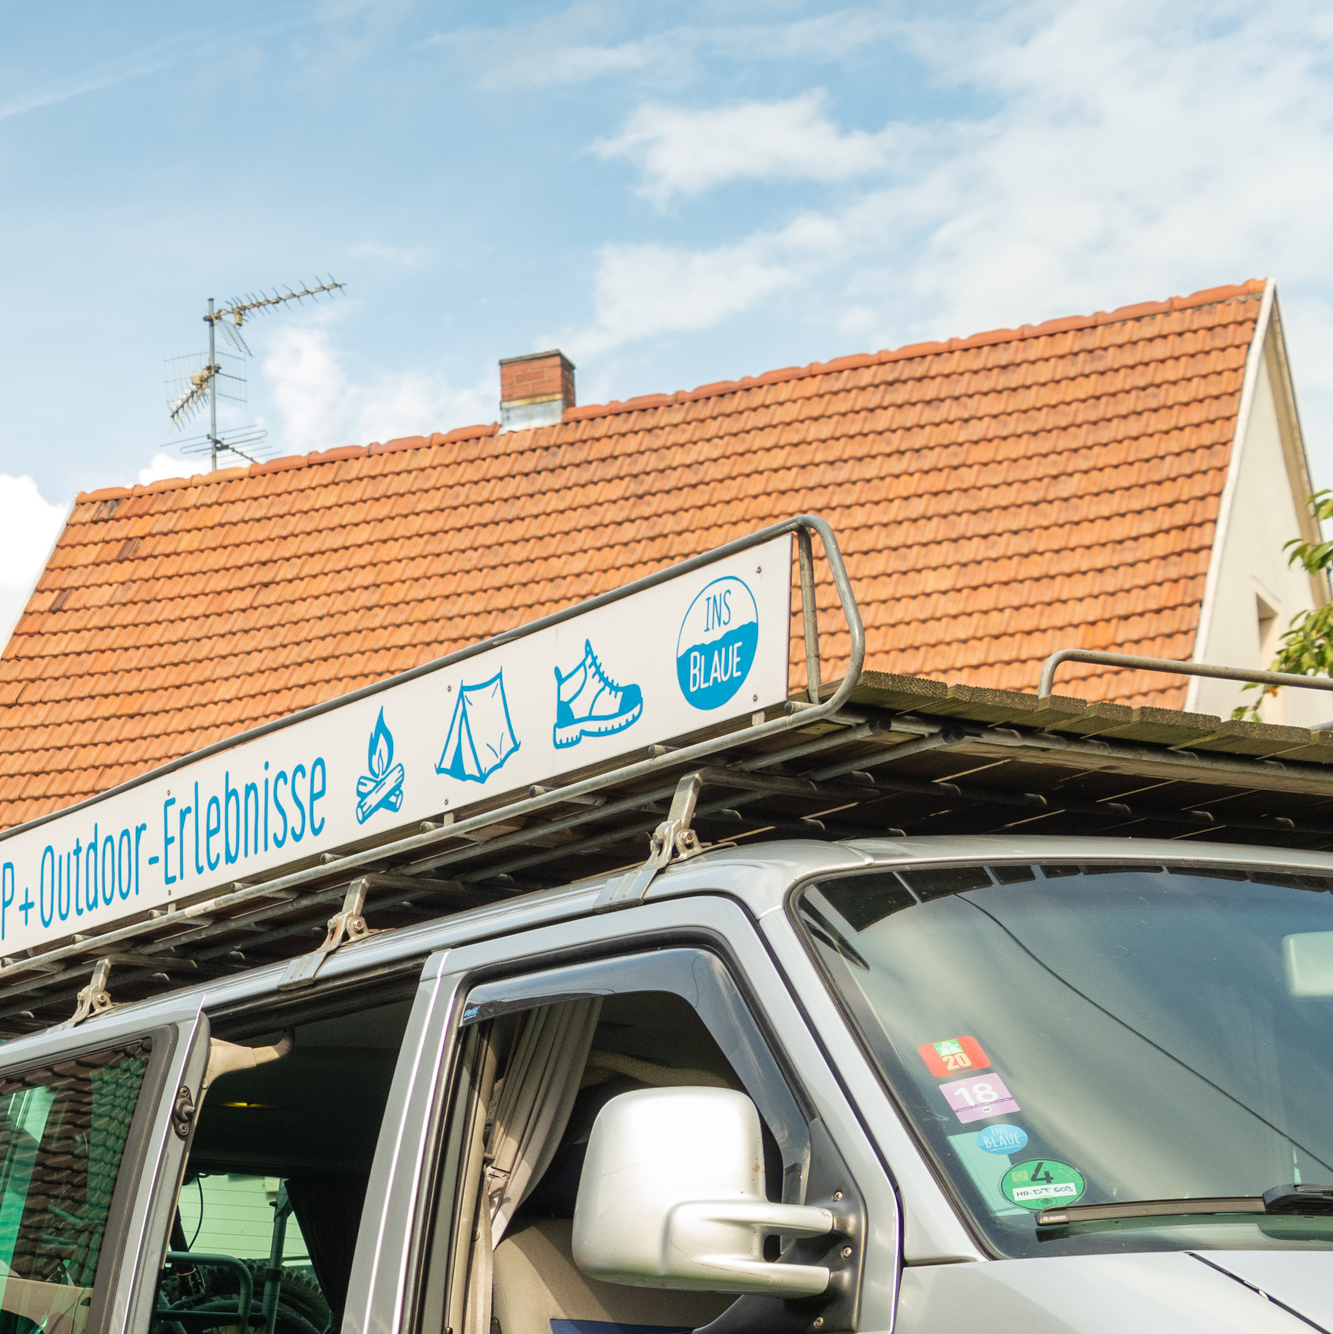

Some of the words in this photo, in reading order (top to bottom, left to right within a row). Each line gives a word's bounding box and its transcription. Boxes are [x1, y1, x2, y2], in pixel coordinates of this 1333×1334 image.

[704, 589, 732, 633] INS
[689, 641, 743, 693] BLAUE
[942, 1052, 972, 1071] 20
[954, 1082, 999, 1107] 18
[982, 1132, 1022, 1149] BLAUE
[990, 1126, 1007, 1136] INS
[1030, 1161, 1054, 1184] 4
